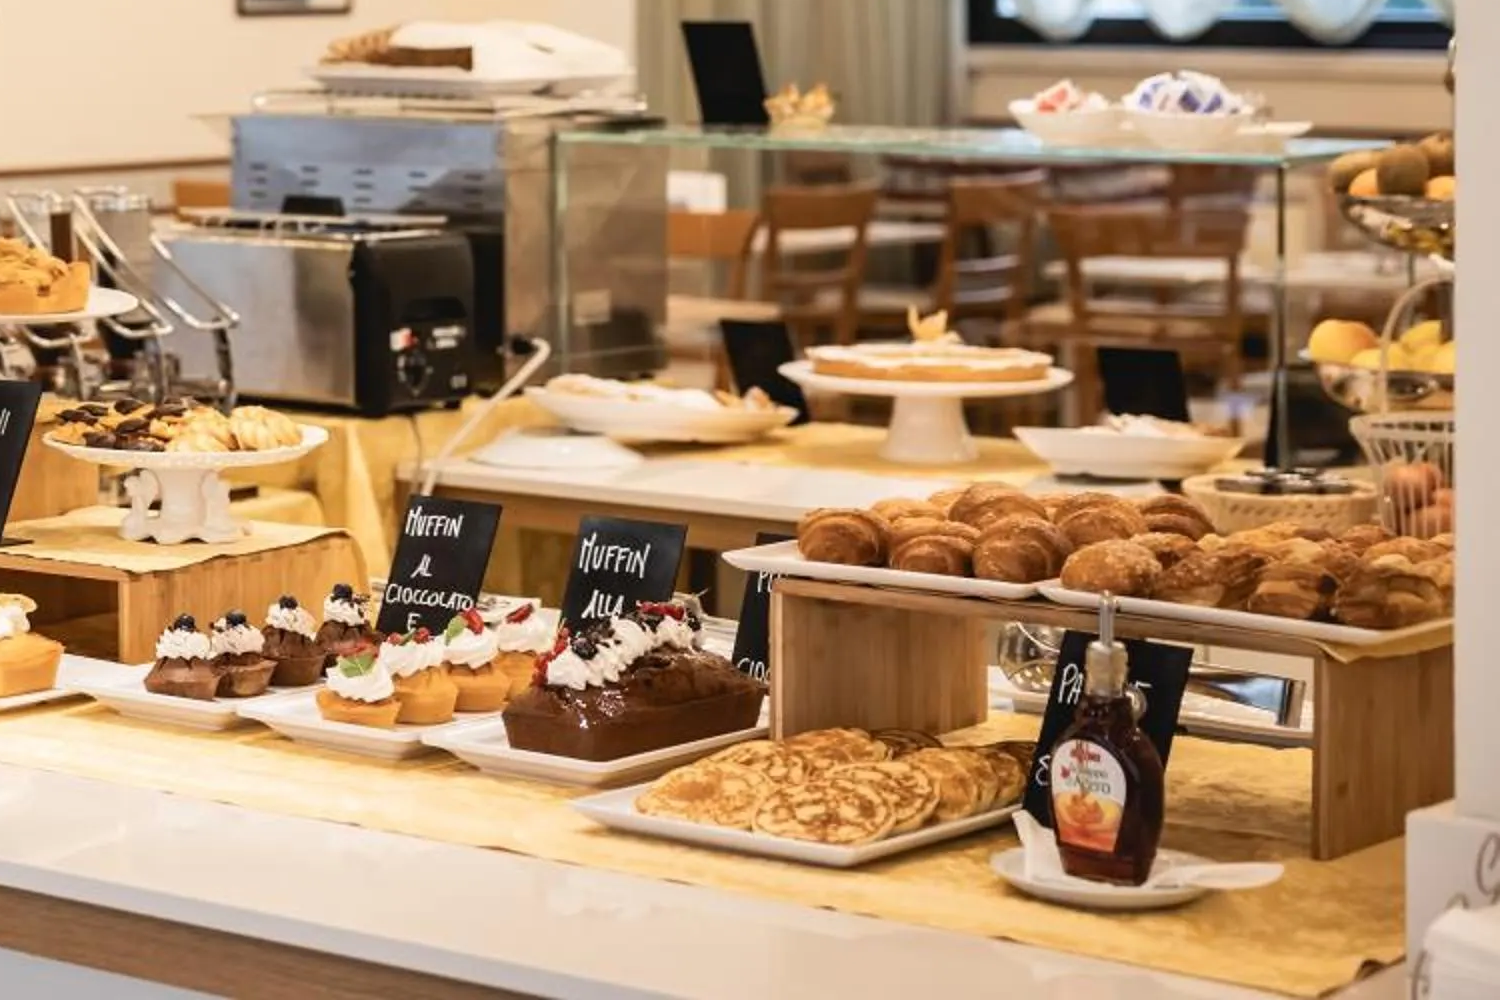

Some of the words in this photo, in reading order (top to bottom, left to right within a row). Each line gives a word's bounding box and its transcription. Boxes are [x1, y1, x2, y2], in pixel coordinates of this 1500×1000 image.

[404, 505, 465, 538] MUFFIN
[411, 554, 432, 577] AL
[579, 532, 651, 579] MUFFIN
[385, 583, 474, 611] CIOCCOLATO
[580, 589, 625, 619] ALLA
[406, 612, 421, 631] E
